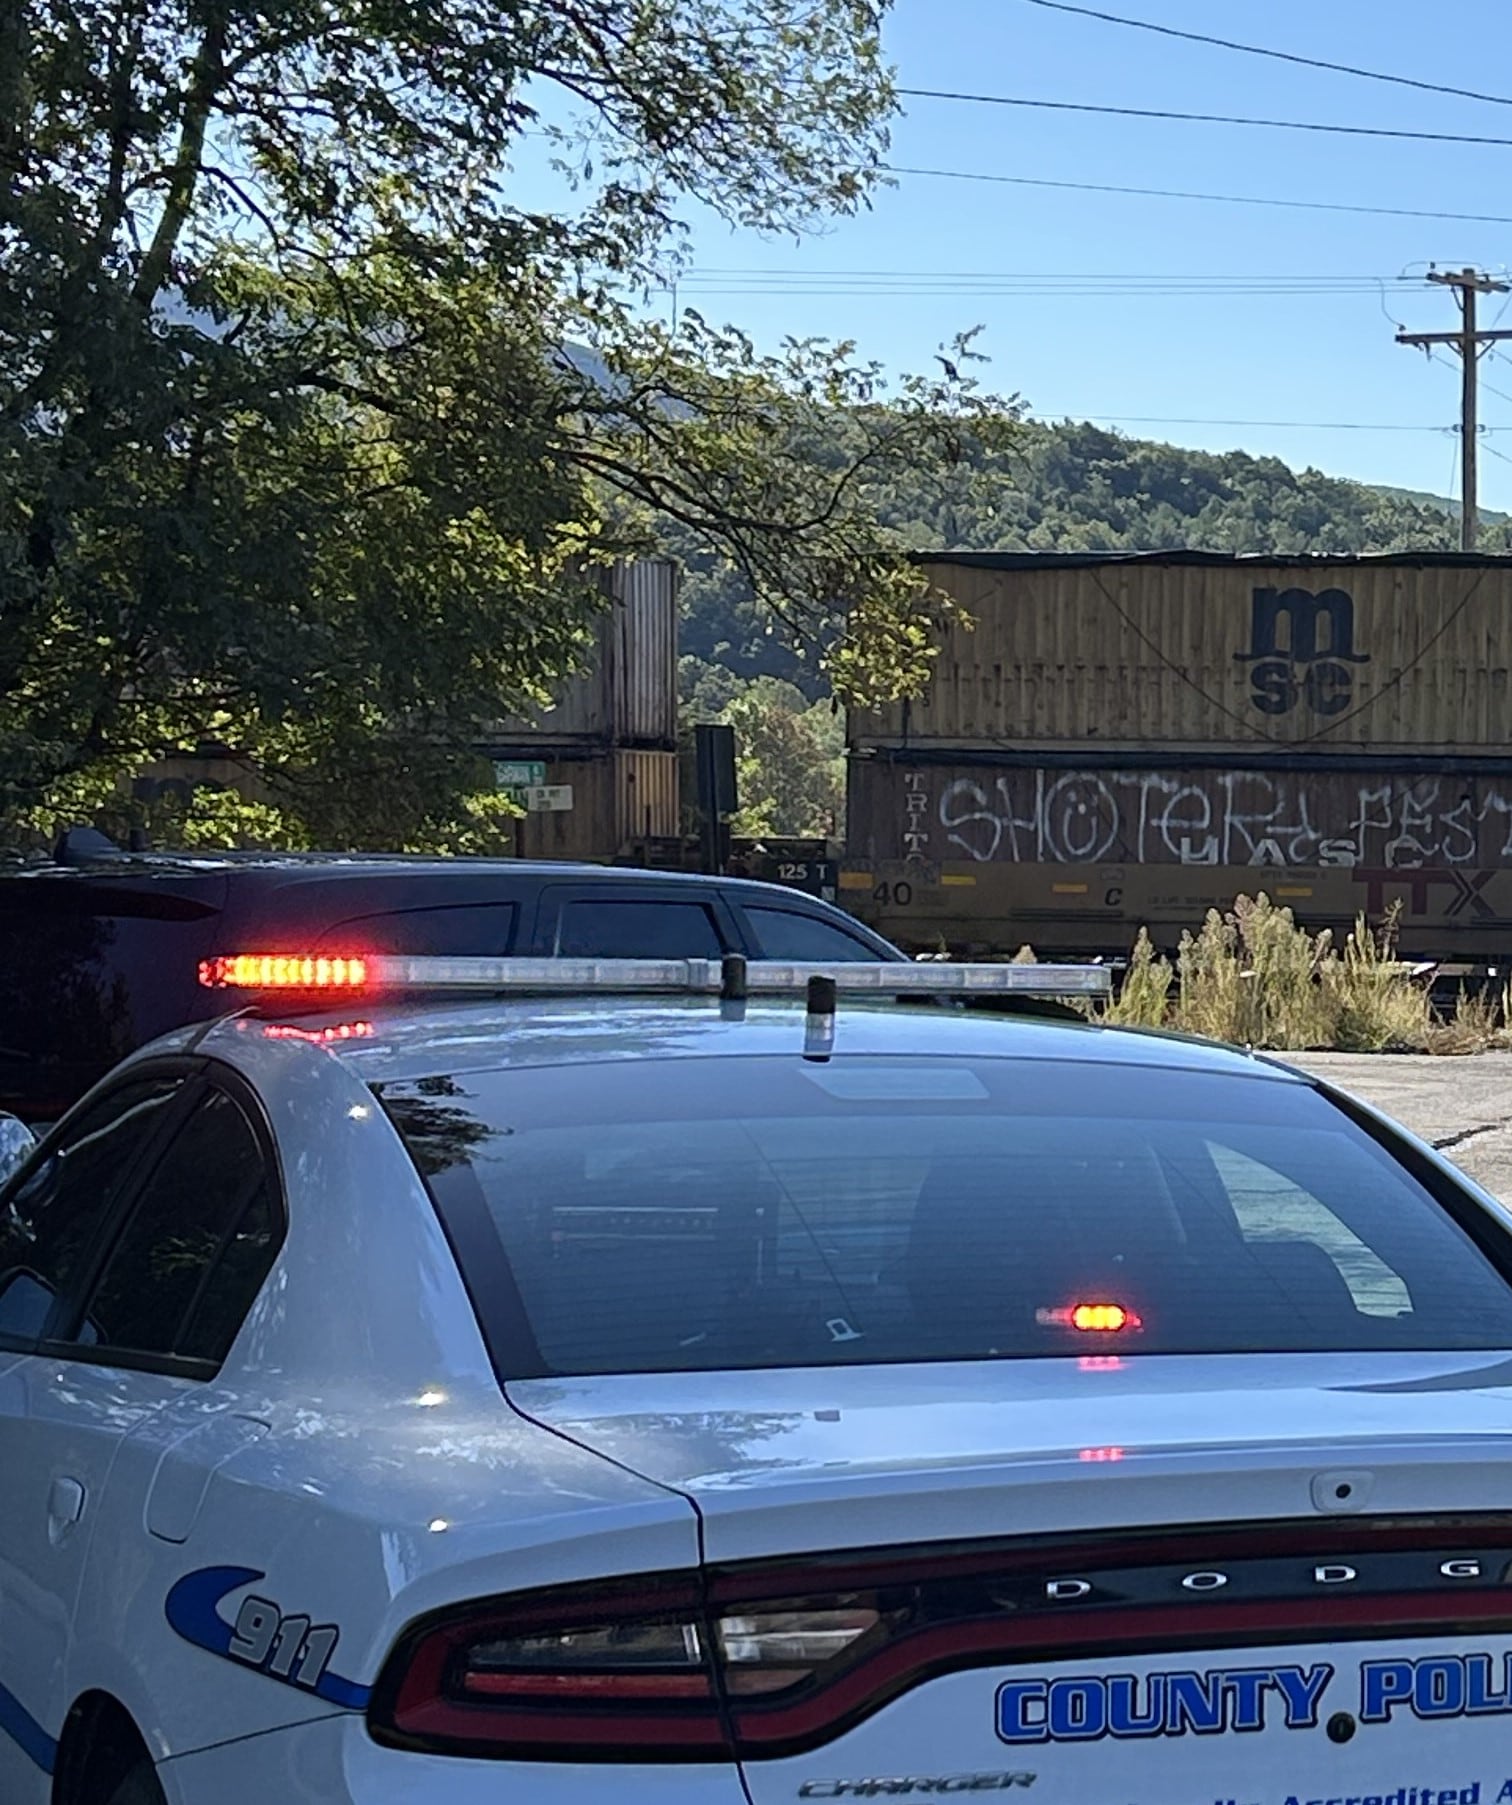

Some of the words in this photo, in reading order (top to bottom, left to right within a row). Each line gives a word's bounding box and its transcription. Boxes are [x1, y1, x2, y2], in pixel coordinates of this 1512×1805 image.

[777, 863, 808, 881] 125
[873, 881, 913, 907] 40
[1351, 868, 1499, 916] TTX
[228, 1595, 340, 1692] 911
[995, 1662, 1334, 1746] COUNTY
[798, 1771, 1038, 1798] CHARGER
